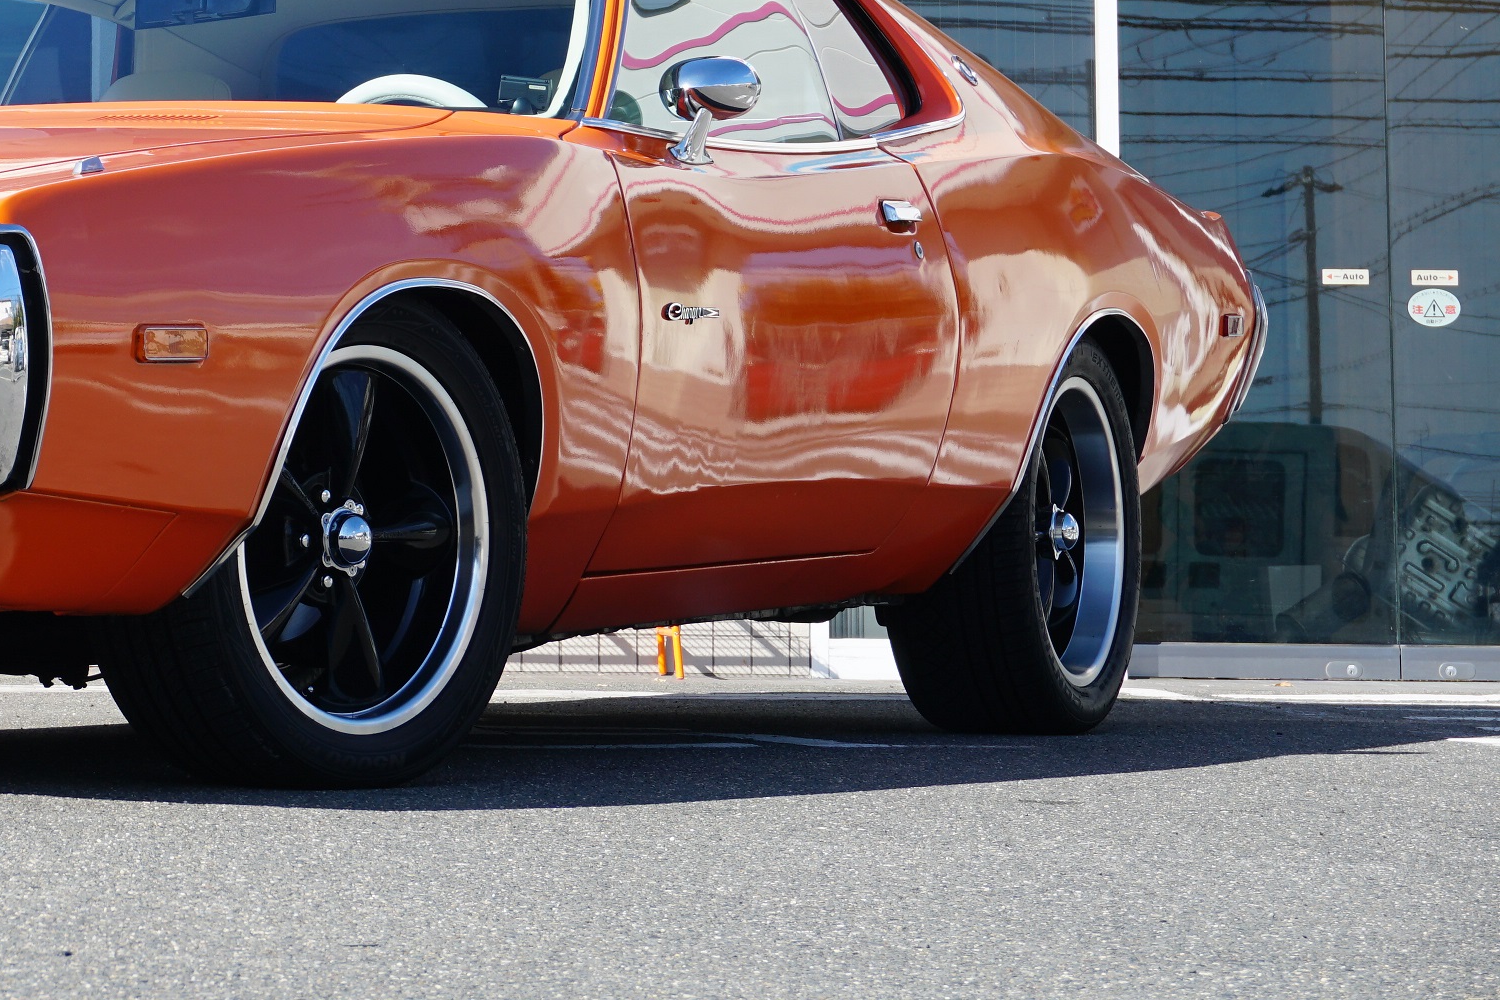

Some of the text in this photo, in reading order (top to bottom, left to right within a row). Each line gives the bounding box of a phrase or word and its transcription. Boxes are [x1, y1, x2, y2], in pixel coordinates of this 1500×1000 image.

[1342, 273, 1365, 281] Auto
[1412, 304, 1457, 315] 注 意
